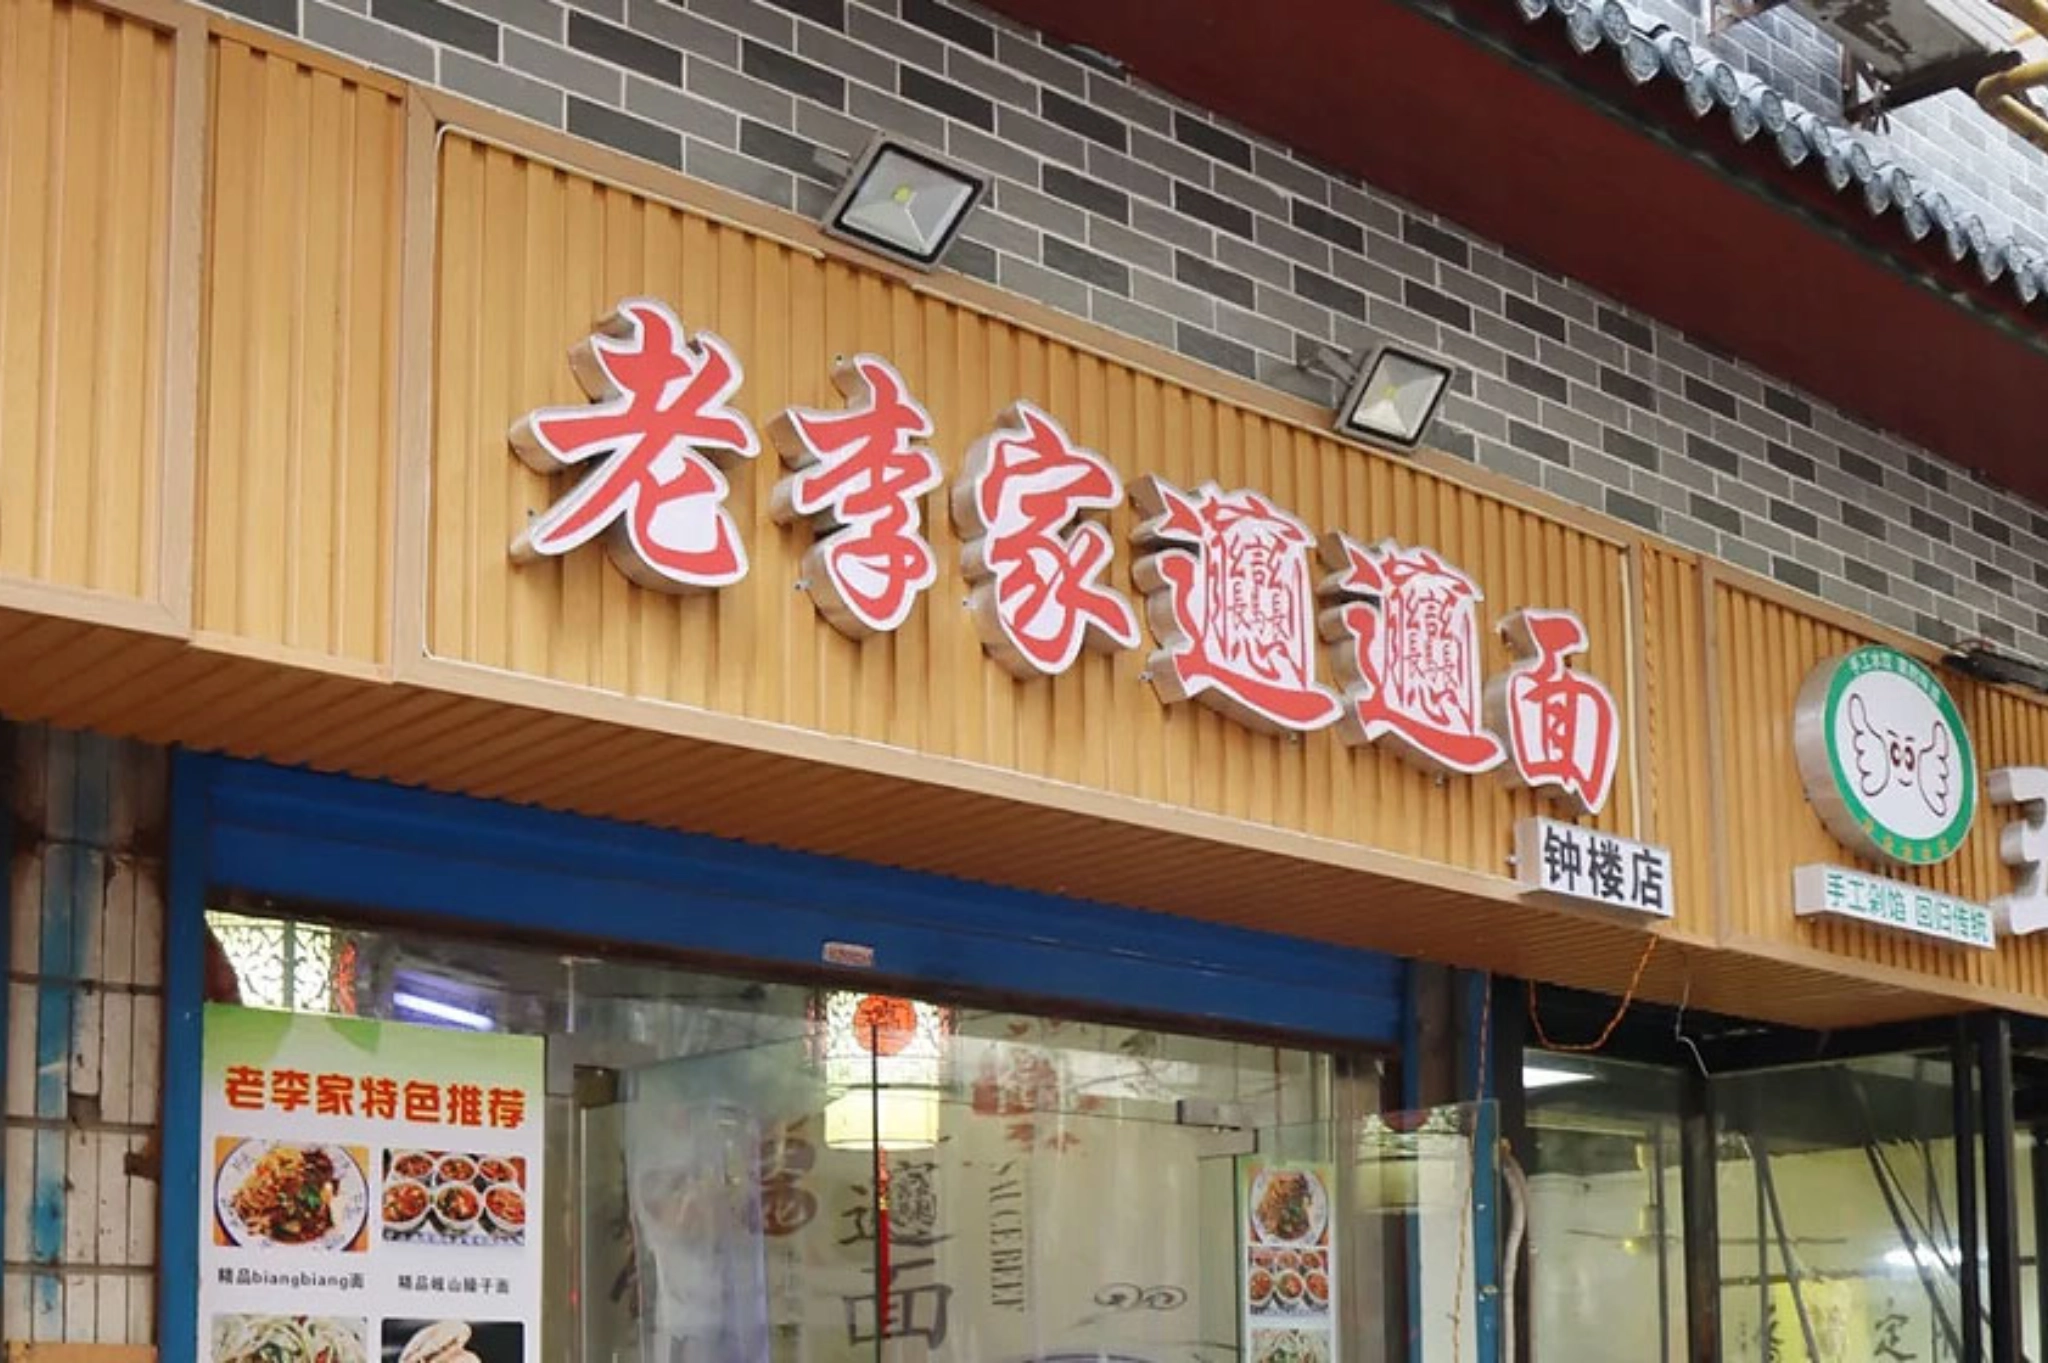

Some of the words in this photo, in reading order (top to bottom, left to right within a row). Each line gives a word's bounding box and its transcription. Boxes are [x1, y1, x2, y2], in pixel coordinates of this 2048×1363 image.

[1544, 824, 1664, 909] 钟楼店
[224, 1065, 526, 1129] 老李家特色推荐
[217, 1266, 365, 1291] 精品biangbiang面
